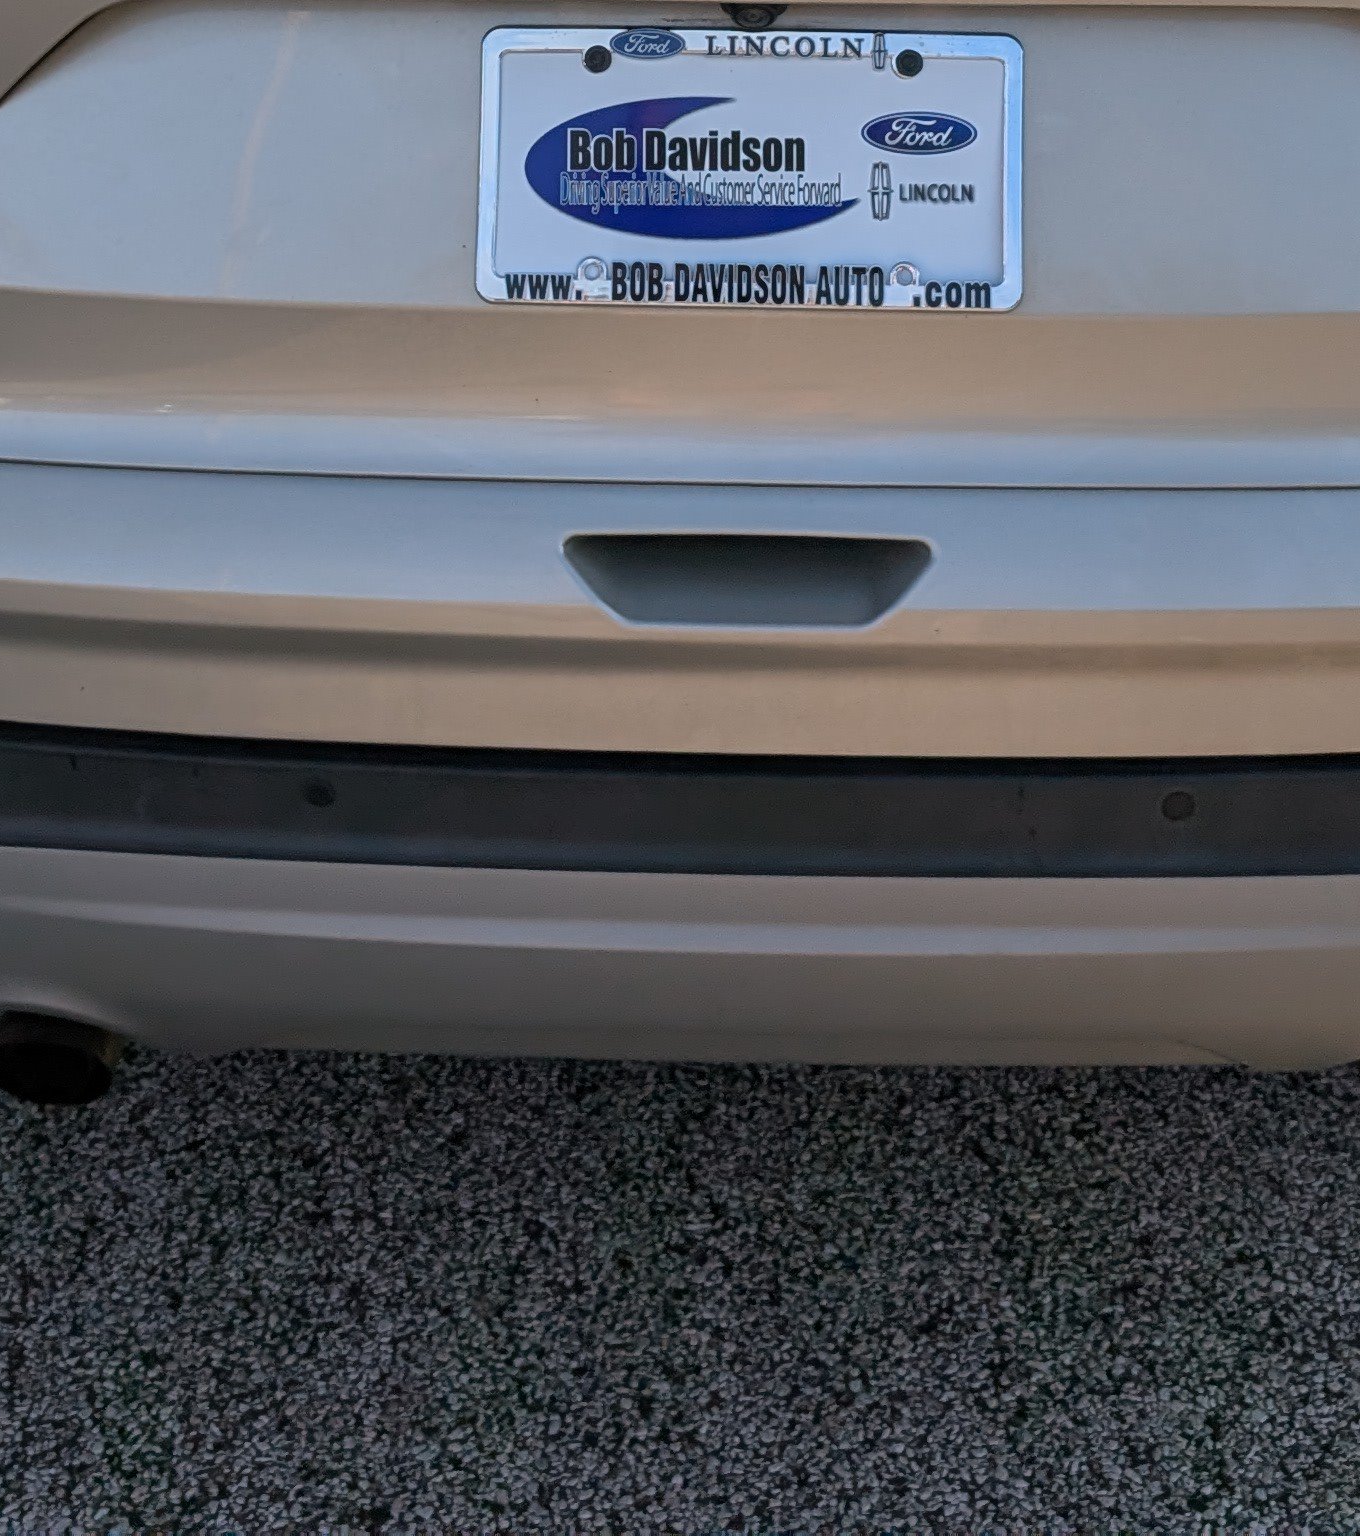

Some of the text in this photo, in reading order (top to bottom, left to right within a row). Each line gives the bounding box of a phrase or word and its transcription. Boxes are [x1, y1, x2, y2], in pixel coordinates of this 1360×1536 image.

[623, 33, 865, 57] Ford LINCOLN
[884, 117, 954, 146] Ford
[569, 129, 805, 172] Bob Davidson
[560, 172, 842, 215] Driving Superior Value And Customer Service Forward
[899, 183, 975, 203] LINCOLN
[505, 262, 991, 308] www. BOB DAVIDSON AUTO .com
